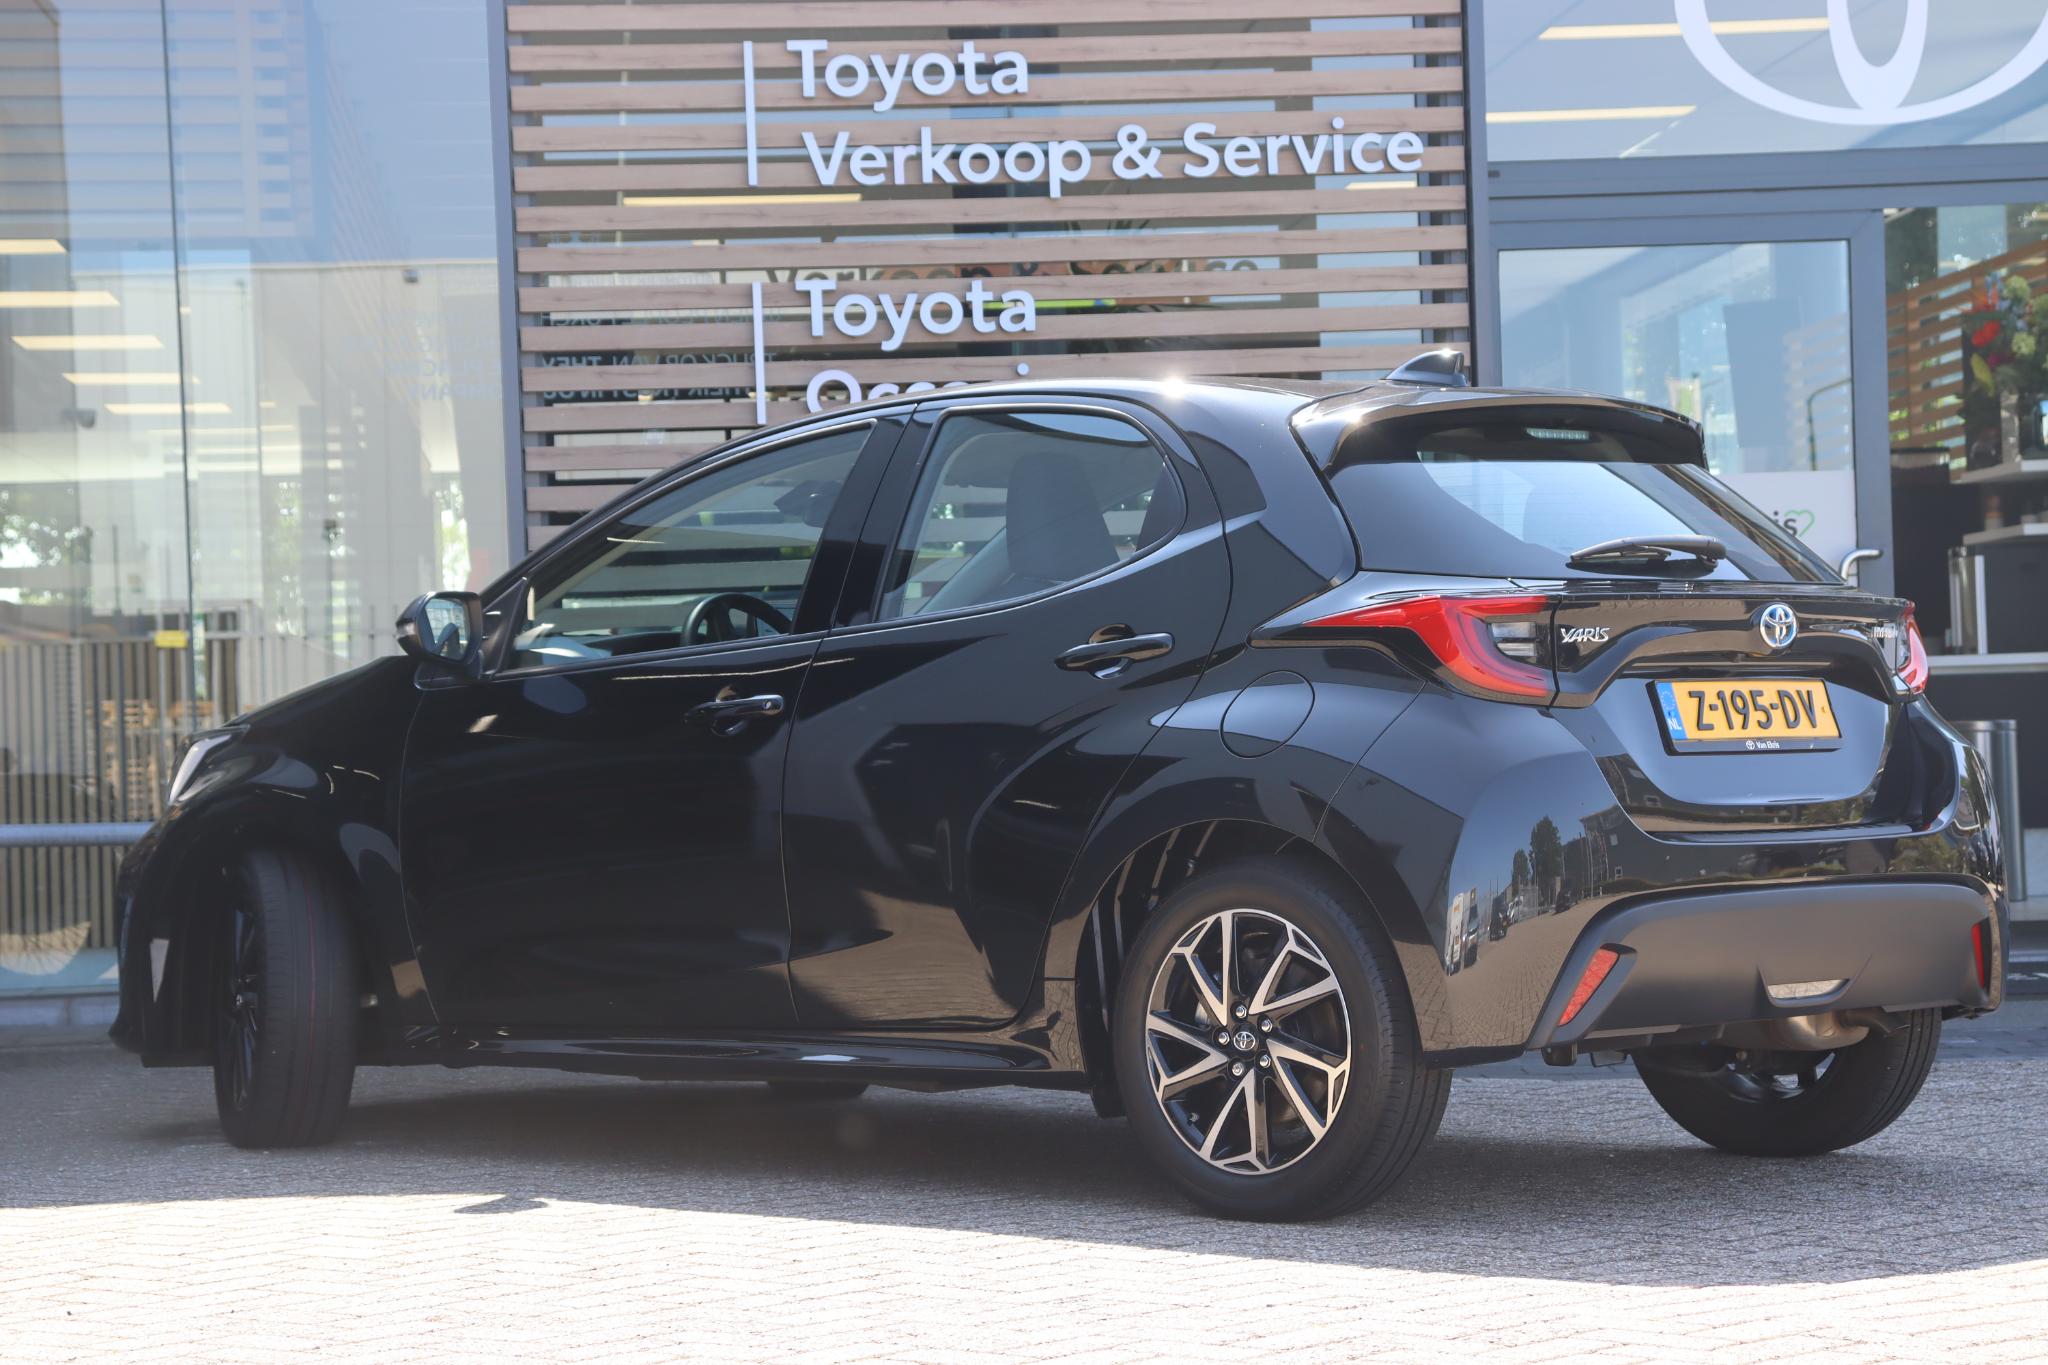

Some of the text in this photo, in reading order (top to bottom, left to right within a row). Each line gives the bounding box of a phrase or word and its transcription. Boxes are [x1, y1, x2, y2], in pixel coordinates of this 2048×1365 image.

[786, 39, 1029, 113] Toyota
[802, 116, 1424, 198] Verkoop & Service
[795, 279, 1037, 351] Toyota
[1560, 627, 1610, 644] YARIS
[1668, 689, 1818, 731] NL Z-195-DV
